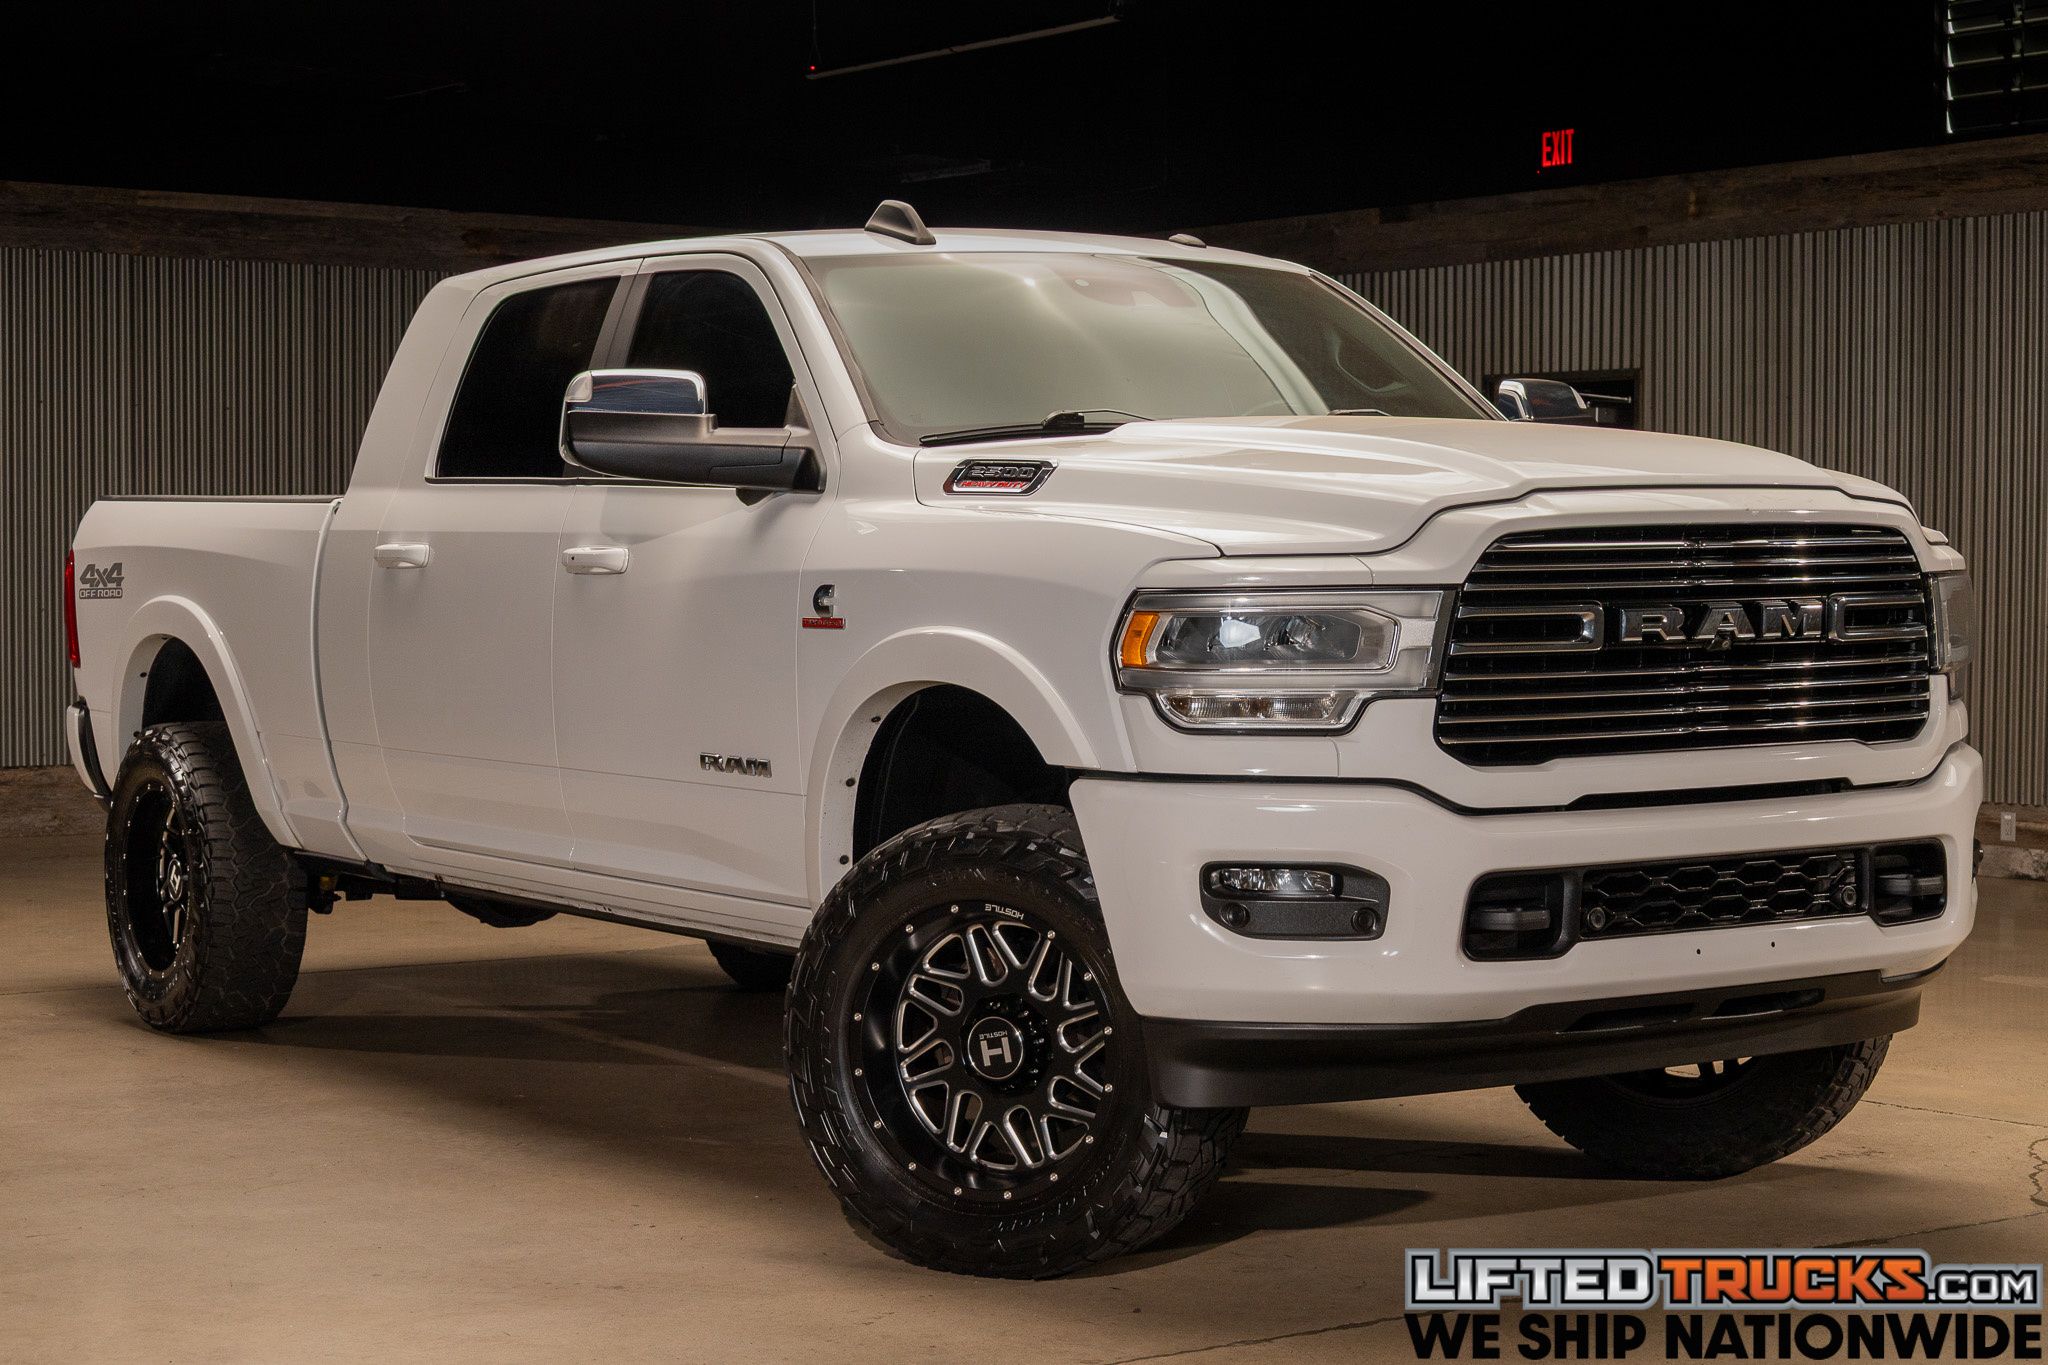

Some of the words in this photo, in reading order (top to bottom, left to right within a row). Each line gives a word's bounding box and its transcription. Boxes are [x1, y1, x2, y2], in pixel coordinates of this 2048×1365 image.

[1542, 128, 1574, 167] EXIT
[968, 465, 1036, 478] 2500
[960, 480, 996, 488] HEAVY
[996, 480, 1027, 489] DUTY
[80, 589, 97, 598] OFF
[97, 588, 122, 598] ROAD
[1620, 600, 1823, 643] RAM
[700, 752, 772, 778] RAM
[985, 903, 1024, 920] HOSTILE
[979, 1030, 1008, 1040] HOSTILE
